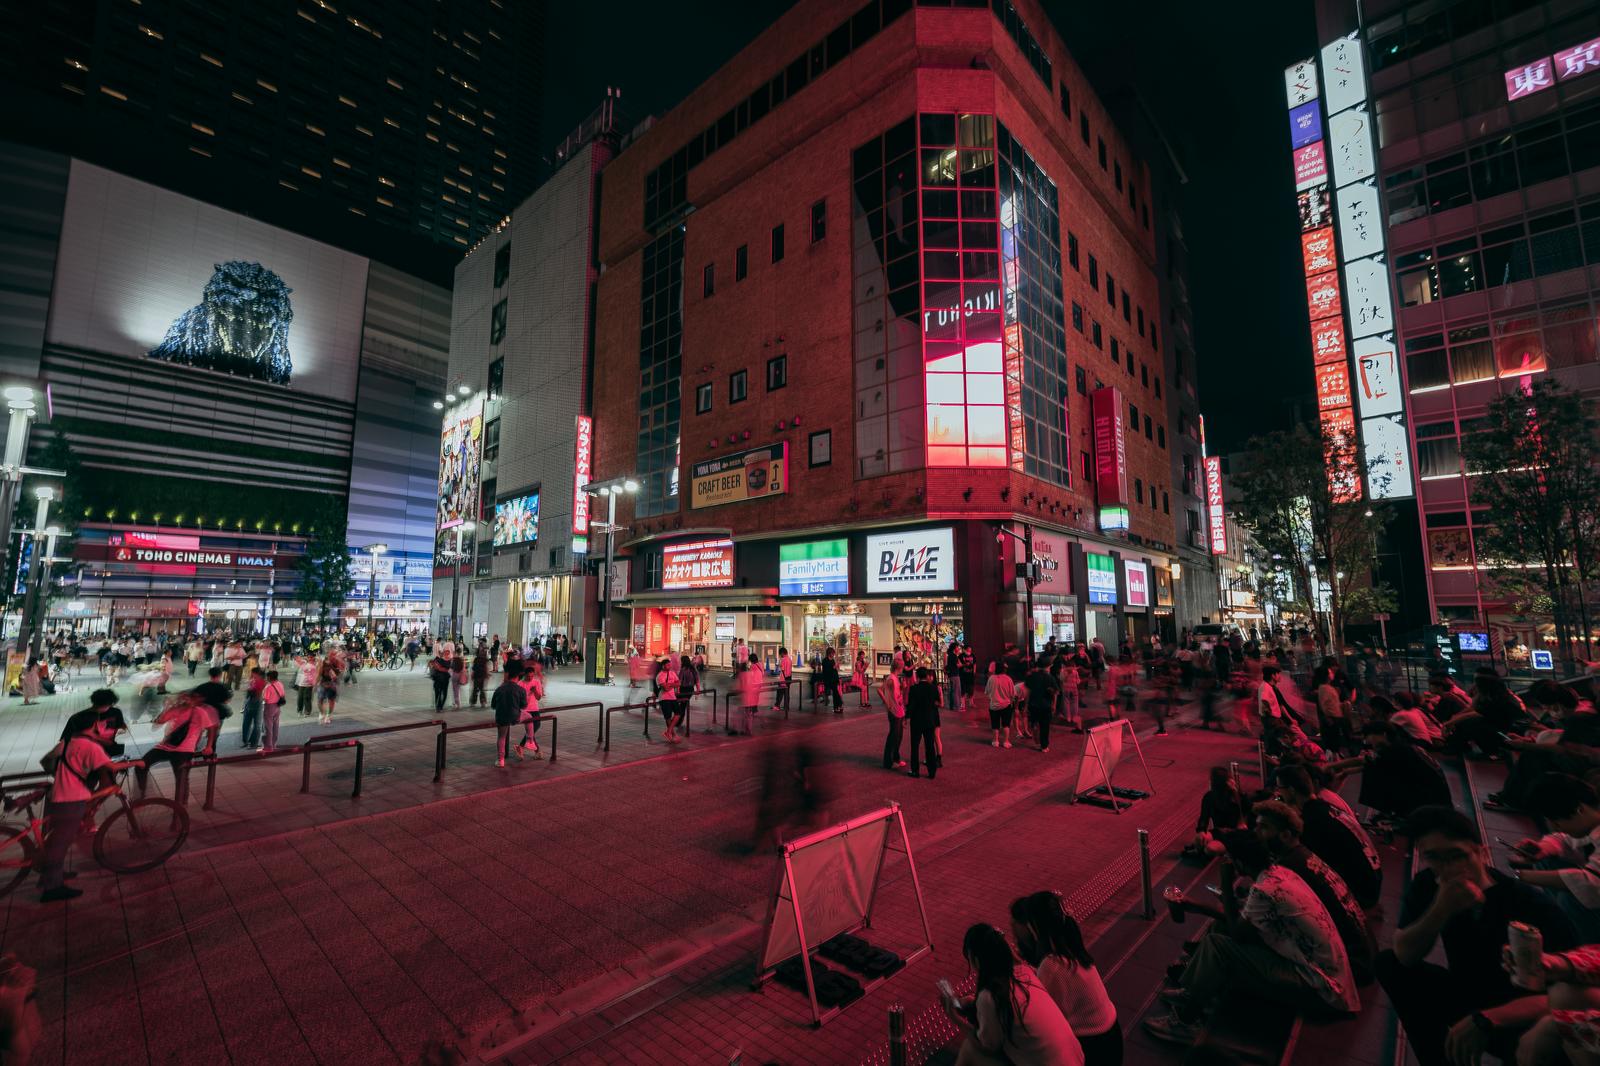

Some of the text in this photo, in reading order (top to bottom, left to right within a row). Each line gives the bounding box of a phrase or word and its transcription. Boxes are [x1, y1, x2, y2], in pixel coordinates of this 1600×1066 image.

[1510, 42, 1600, 97] 東京
[1300, 149, 1318, 161] TCB
[698, 474, 741, 495] CRAFT BEER
[136, 550, 274, 566] TOHO CINEMAS IMAX
[879, 545, 939, 575] BLAZE
[787, 560, 840, 576] FamilyMart
[810, 583, 824, 592] たばこ
